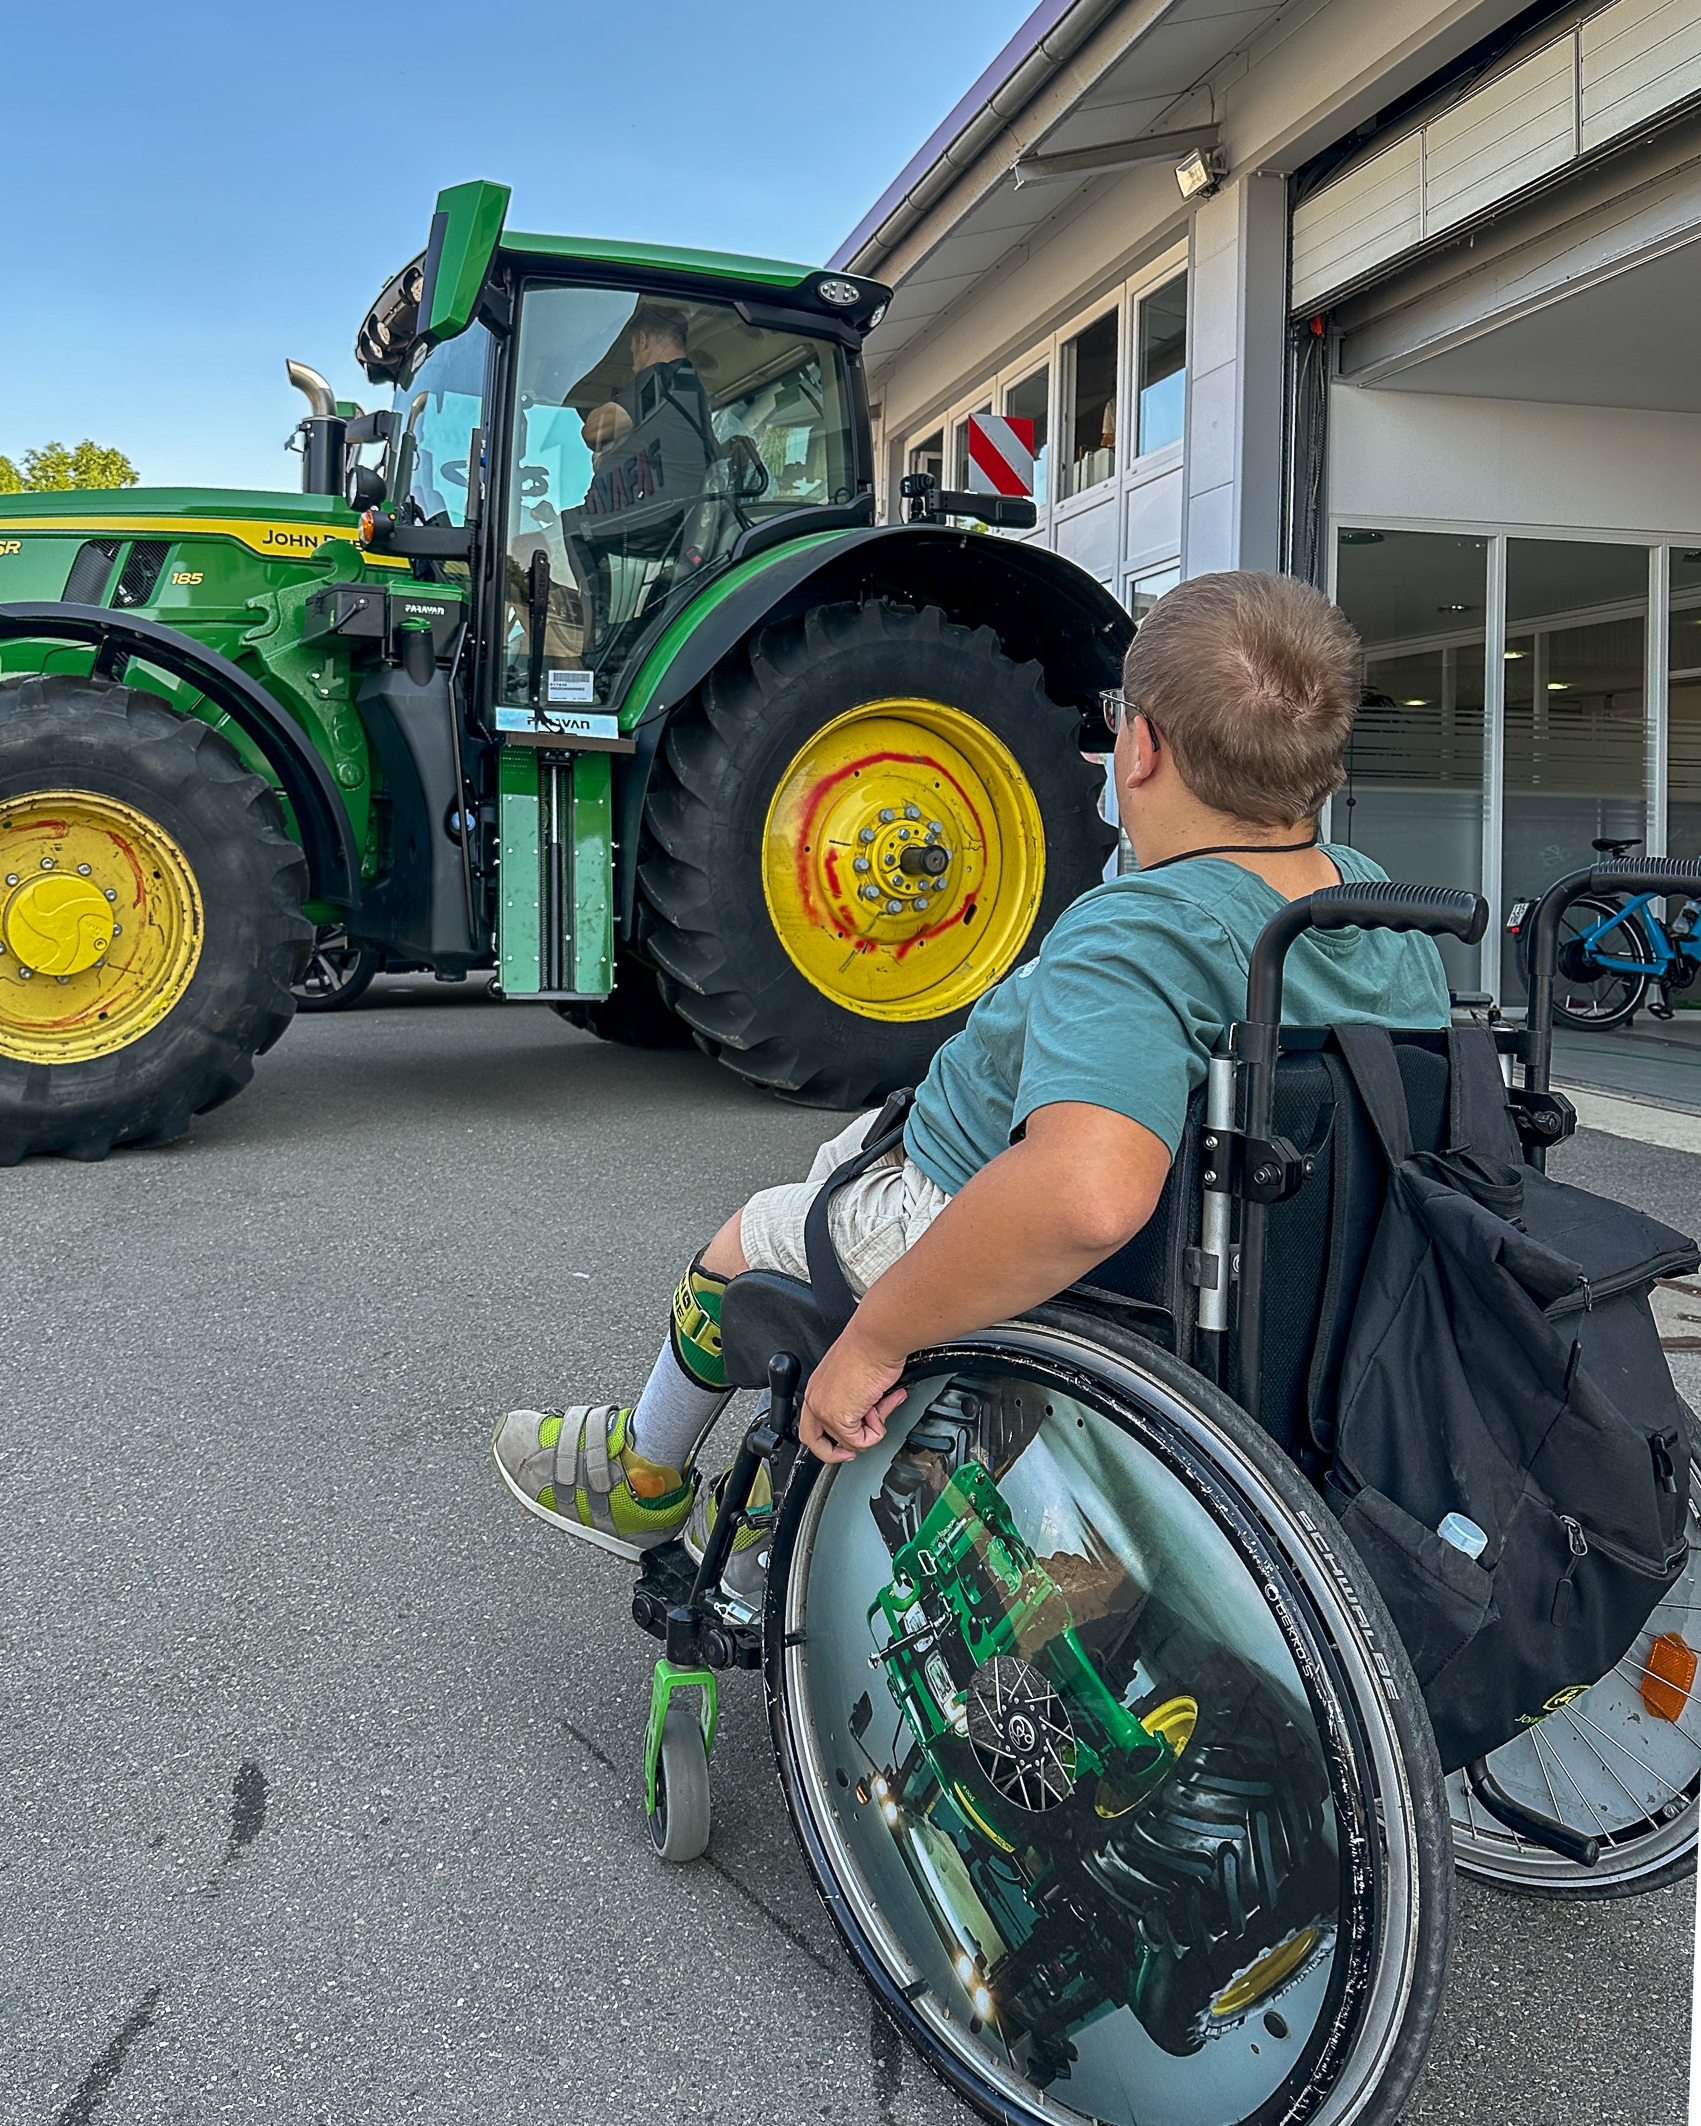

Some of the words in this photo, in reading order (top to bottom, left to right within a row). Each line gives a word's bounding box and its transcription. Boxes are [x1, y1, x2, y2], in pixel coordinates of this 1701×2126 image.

[262, 530, 318, 549] JOHN
[171, 572, 204, 585] 185
[527, 716, 590, 729] PVAN
[1296, 1510, 1399, 1700] SCHWALBE
